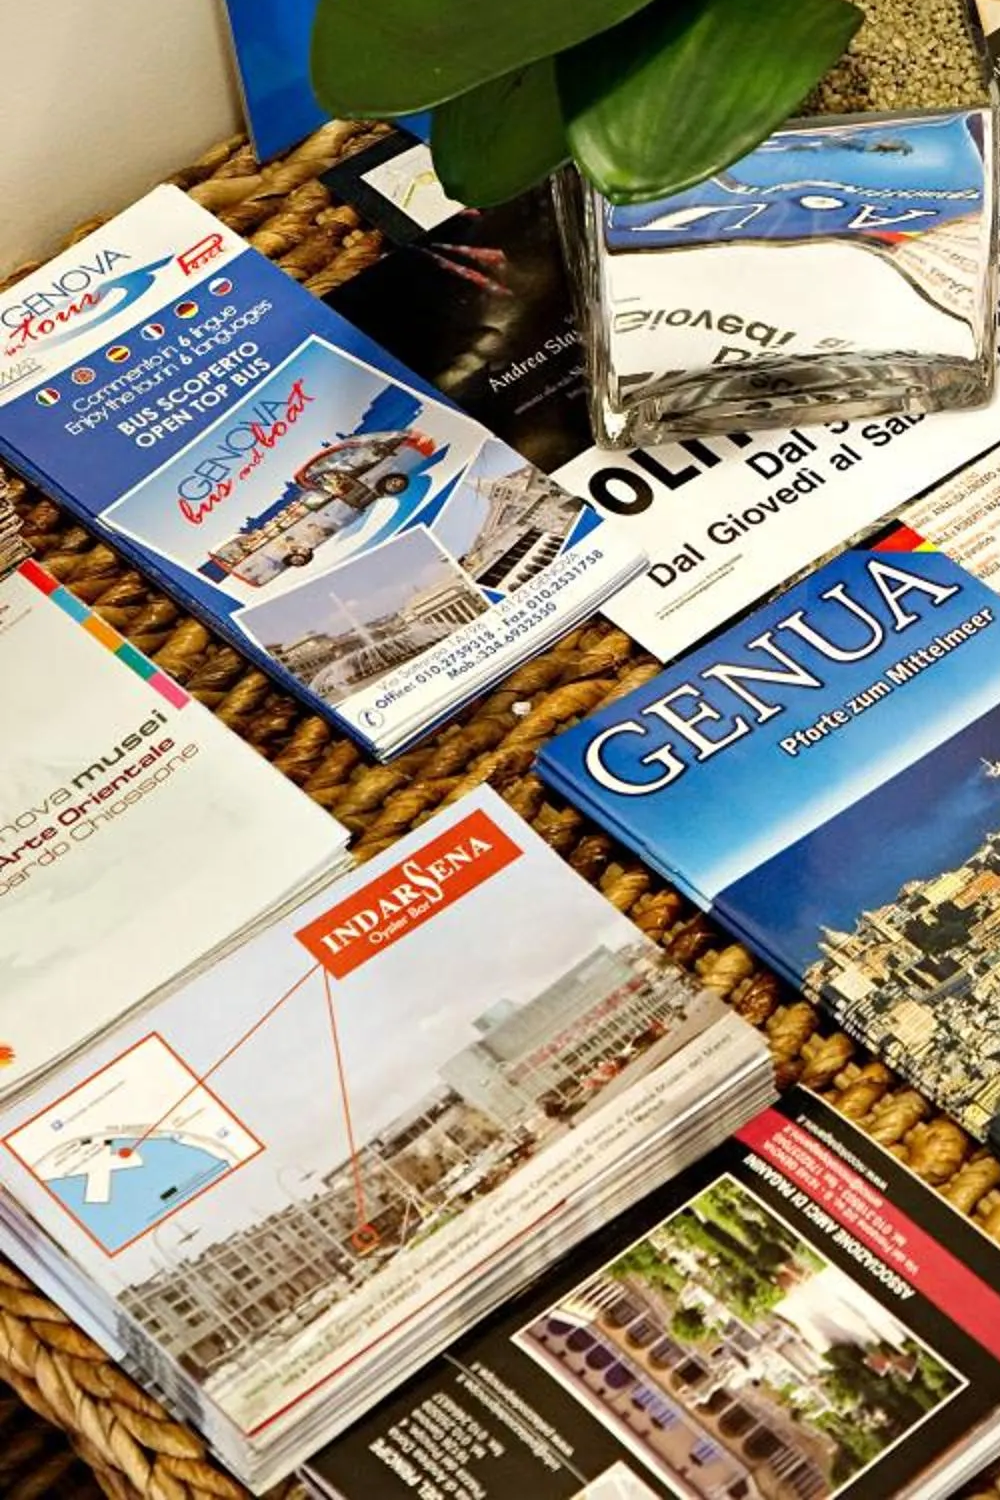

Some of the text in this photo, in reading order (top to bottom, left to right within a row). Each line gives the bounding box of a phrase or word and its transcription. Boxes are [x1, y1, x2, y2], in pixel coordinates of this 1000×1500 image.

[1, 246, 132, 326] GENOVA
[63, 400, 112, 444] Enjoy
[190, 295, 275, 362] languages
[116, 335, 260, 440] BUS SCOPERTO
[133, 353, 272, 454] OPEN TOP BUS
[253, 378, 317, 449] boat
[485, 345, 548, 394] Andrea
[177, 396, 292, 502] GENOVA
[744, 425, 819, 483] Dal
[644, 541, 706, 591] Dal
[705, 460, 827, 552] Giovedì
[826, 438, 863, 474] al
[585, 556, 961, 797] GENUA
[778, 604, 1000, 761] Pforte zum Mittelmeer
[57, 735, 176, 828] Orientale
[69, 741, 200, 843] Chiossone
[70, 709, 169, 792] musei
[319, 835, 495, 955] INDARSENA
[366, 912, 411, 948] Oyster
[741, 1148, 917, 1302] ASSOCIAZIONE AMICI DI PAGANINI
